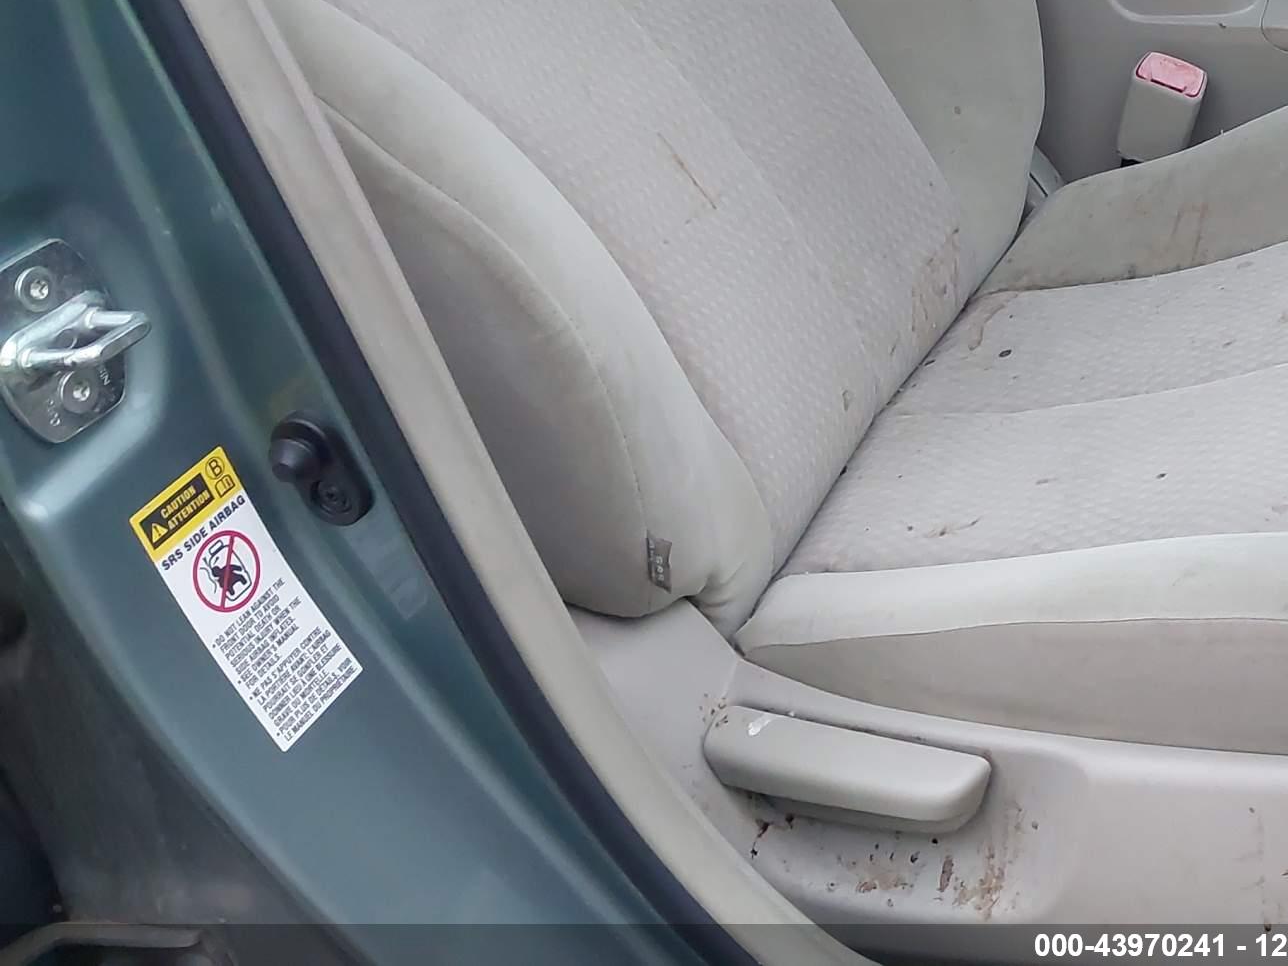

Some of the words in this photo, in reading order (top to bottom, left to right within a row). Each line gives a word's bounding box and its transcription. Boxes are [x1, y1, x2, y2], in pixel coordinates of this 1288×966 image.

[208, 458, 223, 476] B
[160, 485, 197, 519] CAUTION
[167, 490, 211, 530] ATTENTION
[161, 548, 184, 571] SRS
[183, 527, 208, 552] SIDE
[208, 495, 245, 530] AIRBAG
[235, 659, 250, 675] SIDE
[248, 639, 270, 662] AIRBAG
